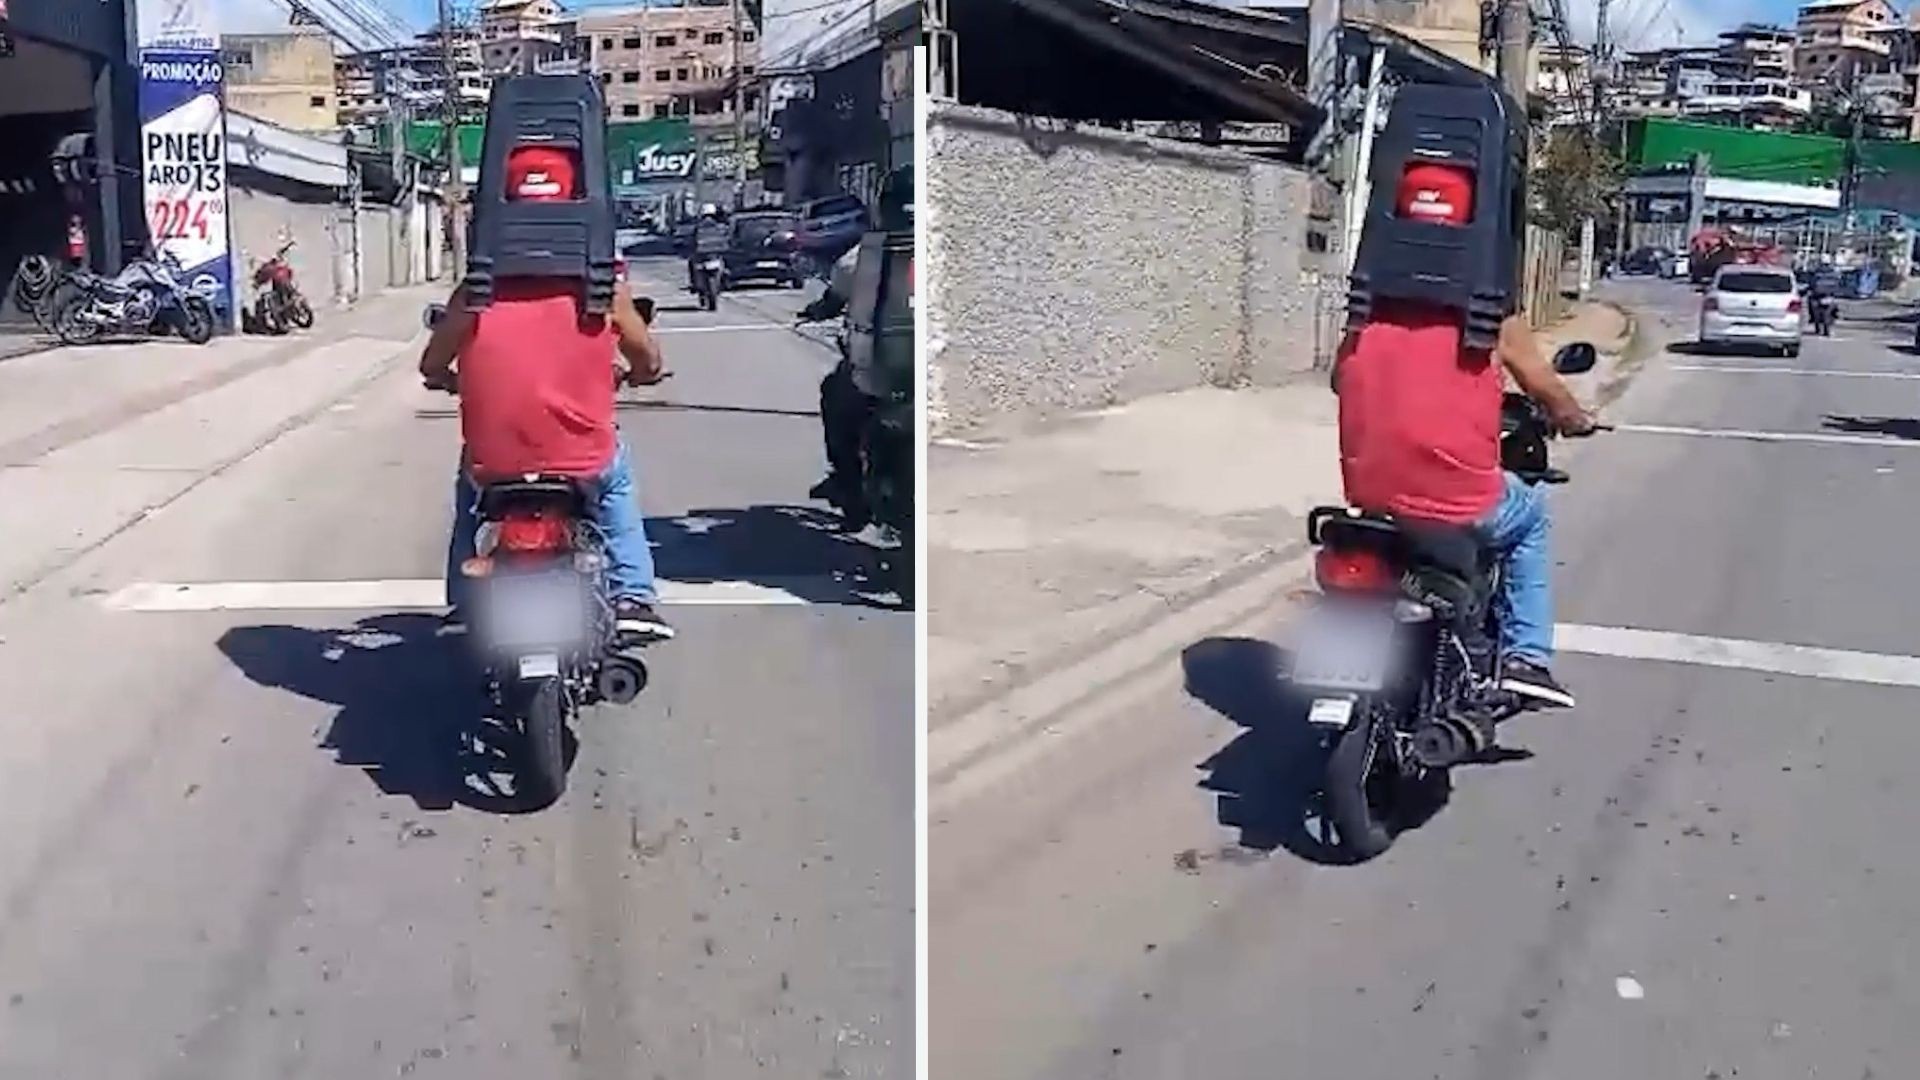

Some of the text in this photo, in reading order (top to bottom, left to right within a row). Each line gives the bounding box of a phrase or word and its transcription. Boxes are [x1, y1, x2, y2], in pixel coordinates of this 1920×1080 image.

[142, 58, 223, 86] PROMOÇÃO
[147, 133, 221, 162] PNEU
[638, 143, 696, 176] Jucy
[148, 164, 222, 192] ARO 13
